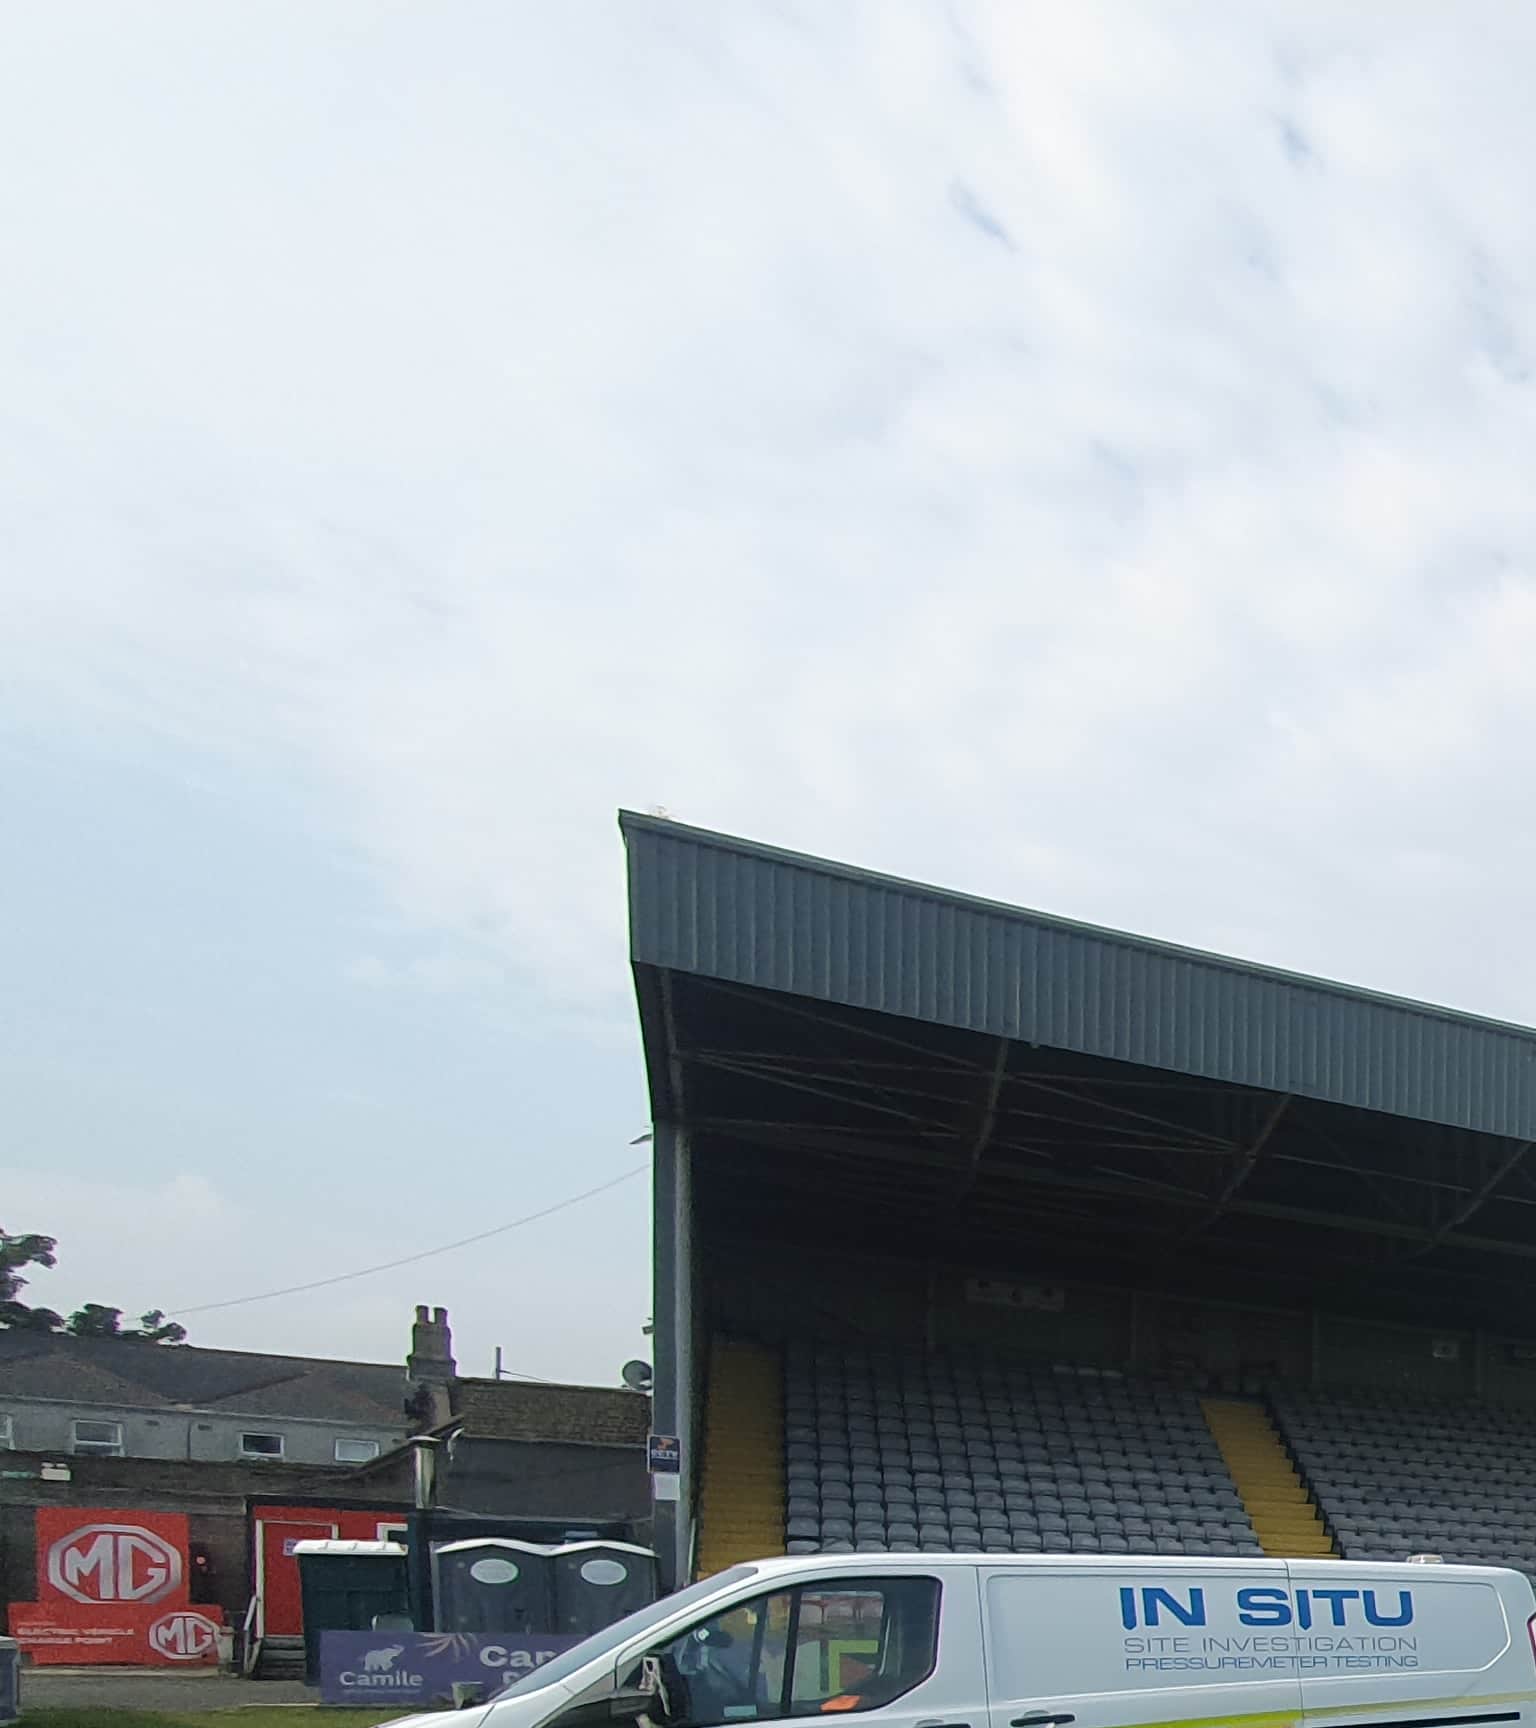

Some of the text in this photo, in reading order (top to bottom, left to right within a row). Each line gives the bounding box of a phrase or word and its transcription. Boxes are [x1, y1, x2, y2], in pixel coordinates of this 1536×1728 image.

[63, 1532, 168, 1600] MG
[1119, 1587, 1415, 1630] IN SITU
[156, 1616, 214, 1655] MG
[1123, 1636, 1419, 1654] SITE INVESTIGATION
[1125, 1655, 1420, 1672] PRESSUREMETER TESTING
[338, 1671, 424, 1687] Camile
